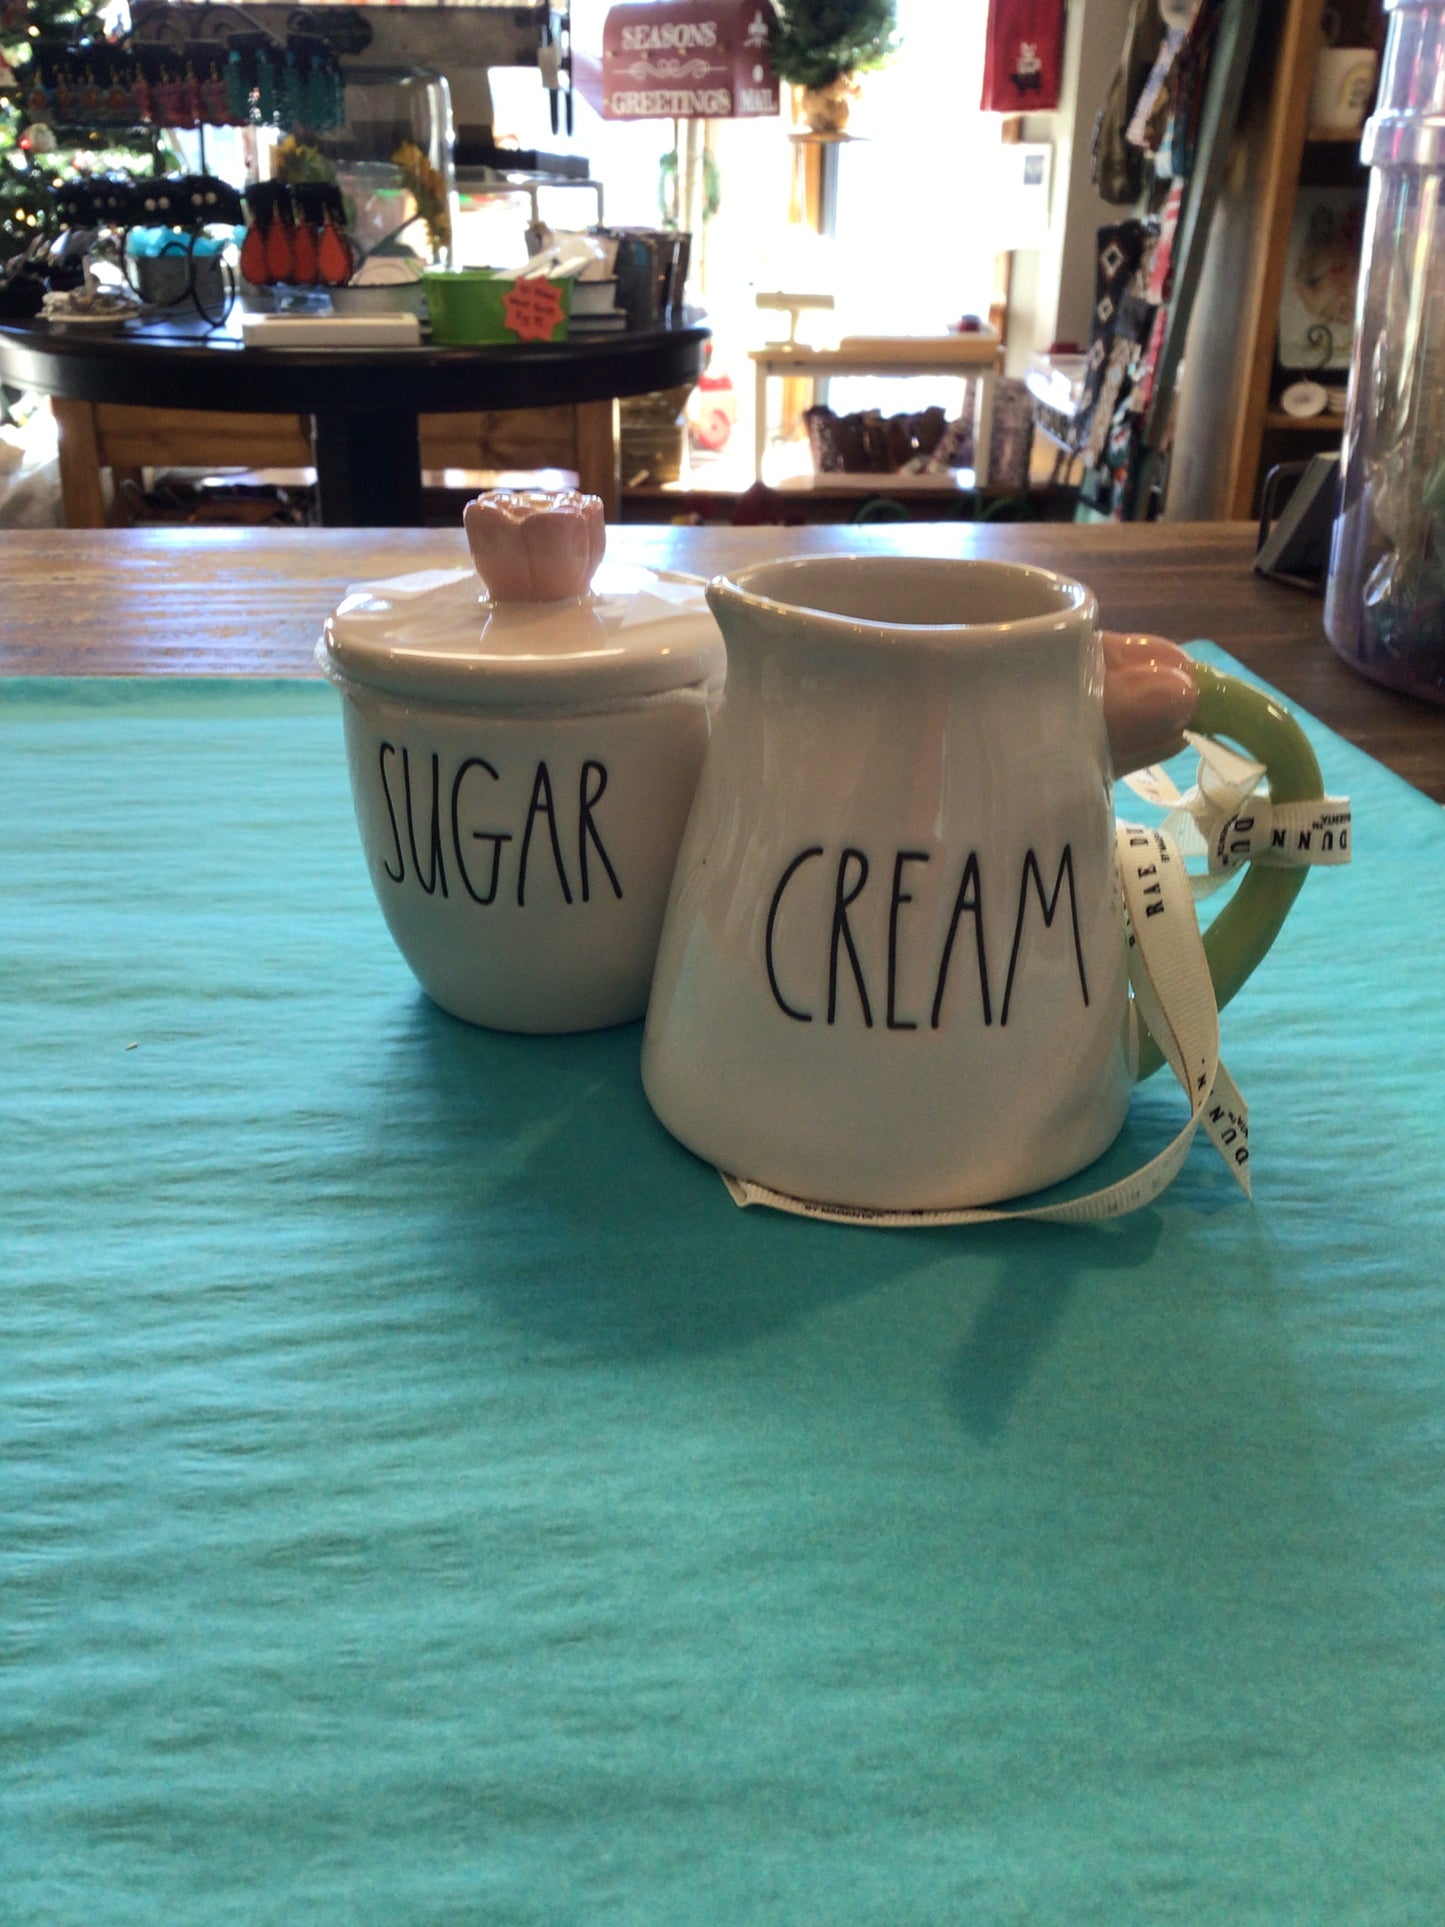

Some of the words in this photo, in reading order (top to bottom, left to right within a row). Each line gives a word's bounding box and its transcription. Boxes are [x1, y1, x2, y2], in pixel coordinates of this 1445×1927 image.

[621, 21, 718, 50] SEASONS
[611, 88, 732, 116] GREETINGS
[741, 88, 778, 113] MAIL
[379, 742, 623, 906] SUGAR
[1271, 828, 1349, 851] DUNN
[1138, 863, 1165, 918] RAE
[766, 844, 1089, 1029] CREAM
